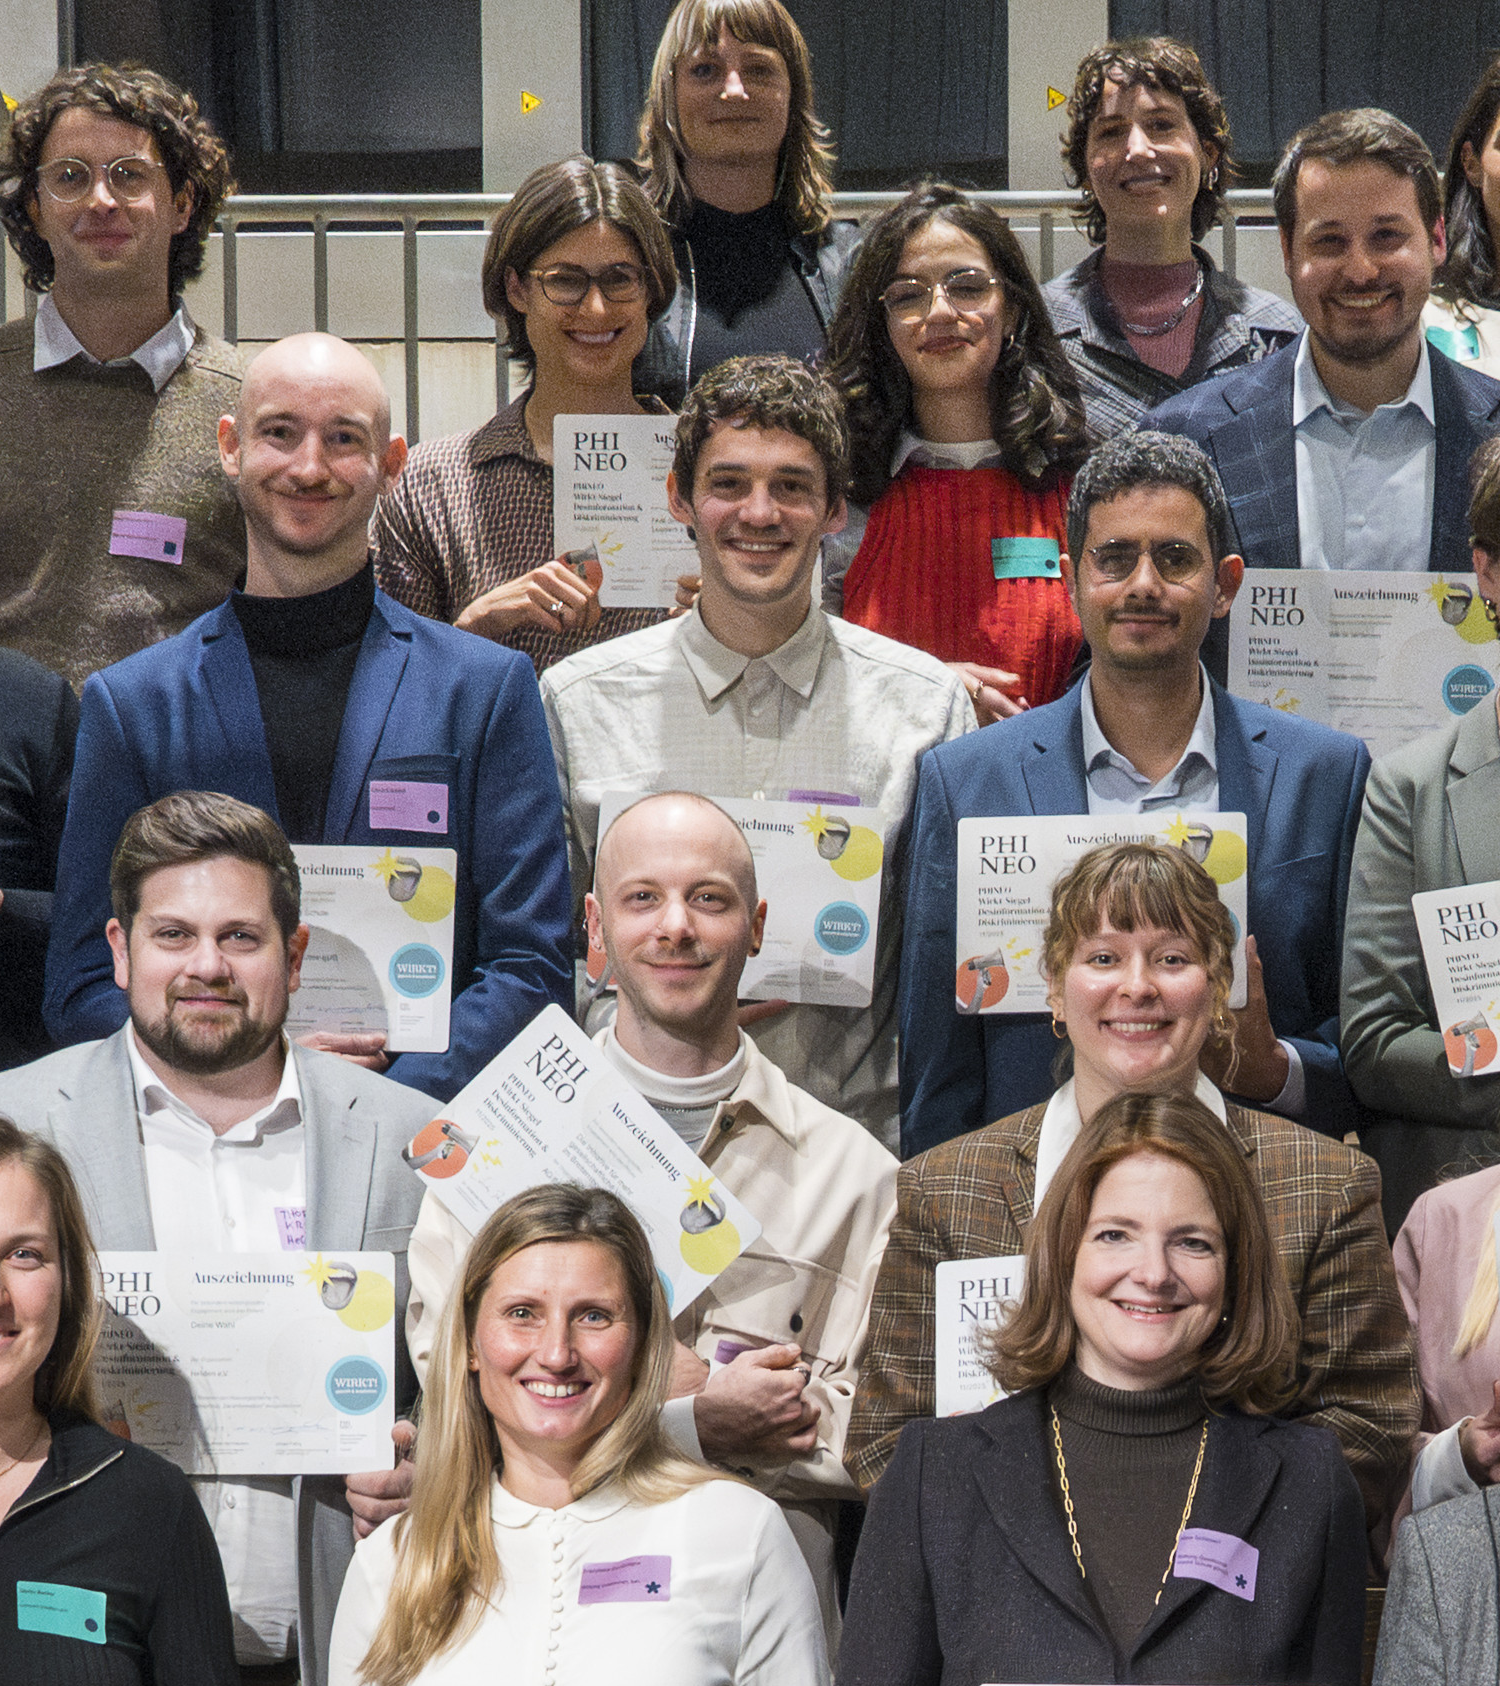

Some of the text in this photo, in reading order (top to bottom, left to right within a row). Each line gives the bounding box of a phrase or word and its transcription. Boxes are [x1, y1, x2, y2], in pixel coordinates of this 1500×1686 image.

[573, 432, 618, 450] PHI
[574, 452, 626, 470] NEO
[1251, 586, 1296, 605] PHI
[1250, 607, 1304, 625] NEO
[979, 835, 1027, 854] PHI
[979, 855, 1036, 874] NEO
[1436, 902, 1486, 925] PHI
[1440, 920, 1498, 945] NEO
[541, 1032, 589, 1083] PHI
[524, 1049, 576, 1103] NEO
[959, 1277, 1010, 1299] PHI
